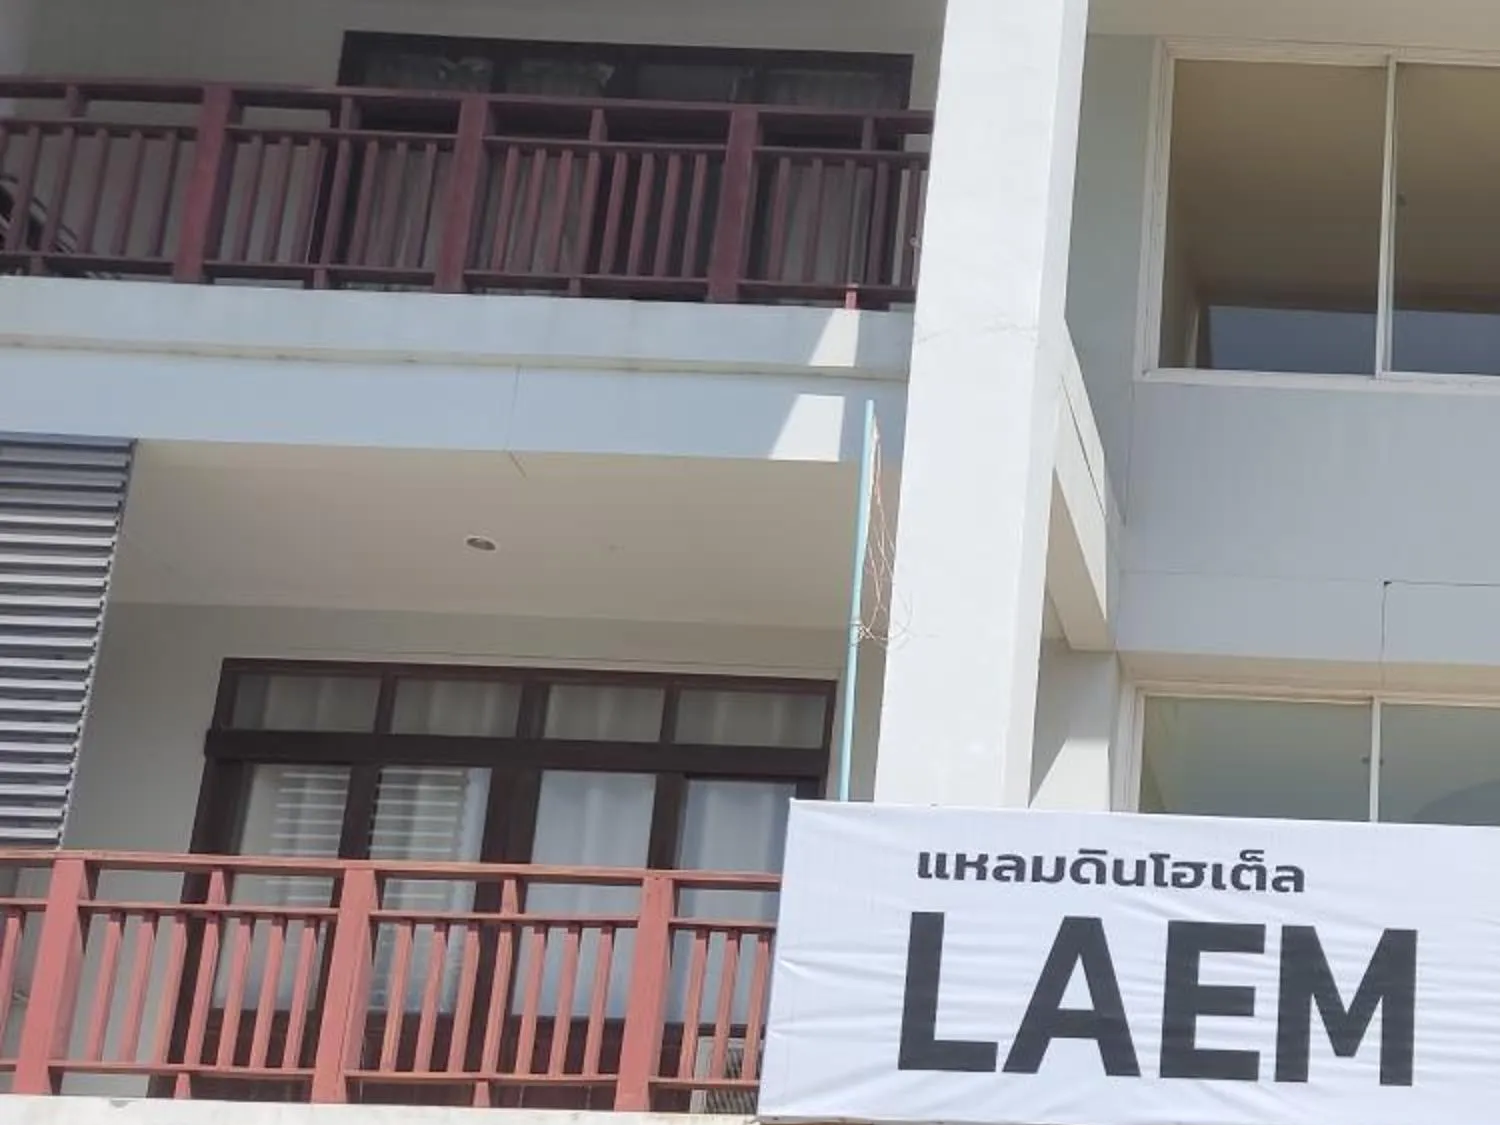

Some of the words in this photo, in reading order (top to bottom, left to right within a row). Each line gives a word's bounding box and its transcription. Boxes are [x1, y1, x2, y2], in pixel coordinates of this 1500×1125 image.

[917, 849, 1305, 893] แหลมดินโฮเต็ล
[898, 911, 1417, 1086] LAEM
